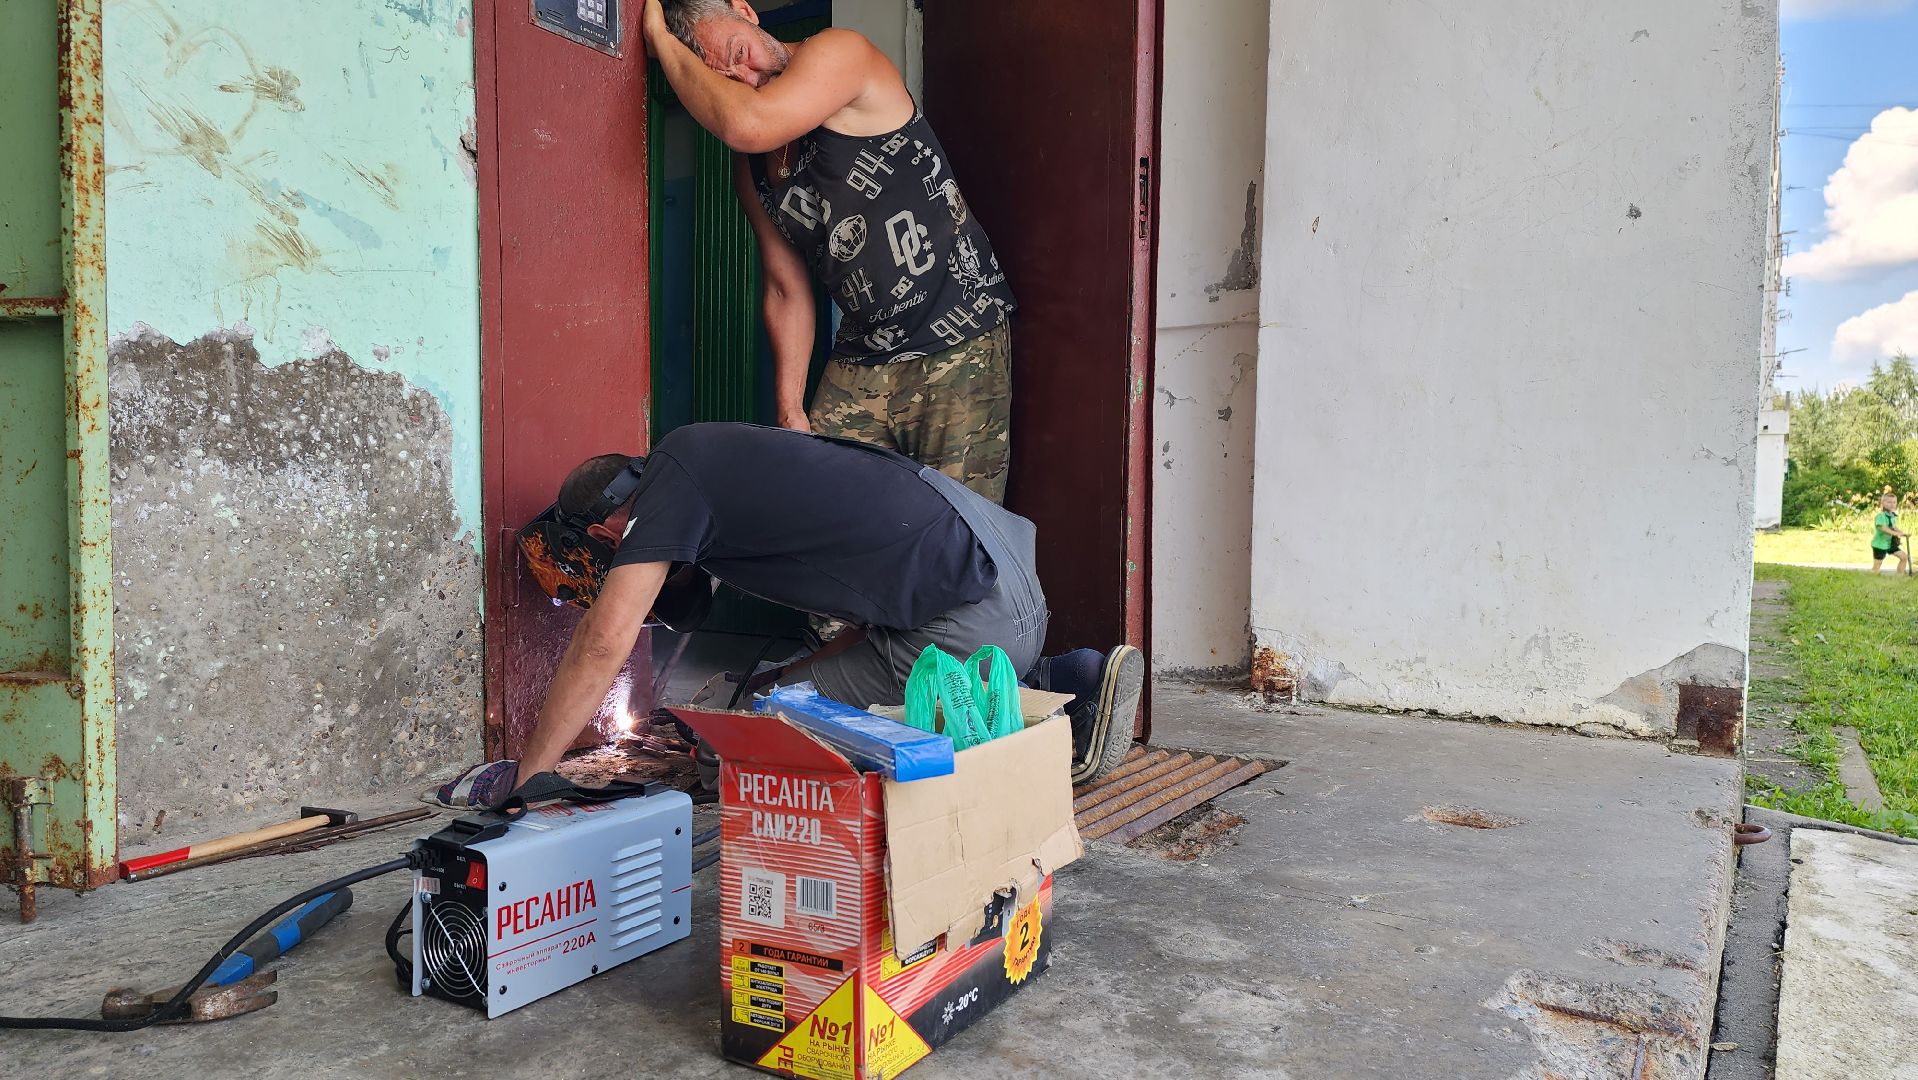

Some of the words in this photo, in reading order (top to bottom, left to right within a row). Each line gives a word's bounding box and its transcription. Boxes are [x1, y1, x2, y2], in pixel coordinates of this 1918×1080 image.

[846, 148, 895, 200] 94
[884, 209, 936, 276] DC
[841, 266, 876, 312] 94
[868, 290, 928, 323] Authentic
[930, 304, 982, 346] 94
[739, 772, 835, 813] РЕСАНТА
[752, 810, 821, 846] САИ220
[496, 878, 597, 940] РЕСАНТА
[738, 942, 745, 952] 2
[1019, 921, 1030, 952] 2
[763, 947, 785, 959] ГОДА
[786, 950, 830, 968] ГАРАНТИИ
[809, 1013, 853, 1046] №1
[809, 1038, 820, 1048] НА
[822, 1041, 850, 1054] РЫНКЕ
[806, 1047, 851, 1063] СВАРОЧНОГО
